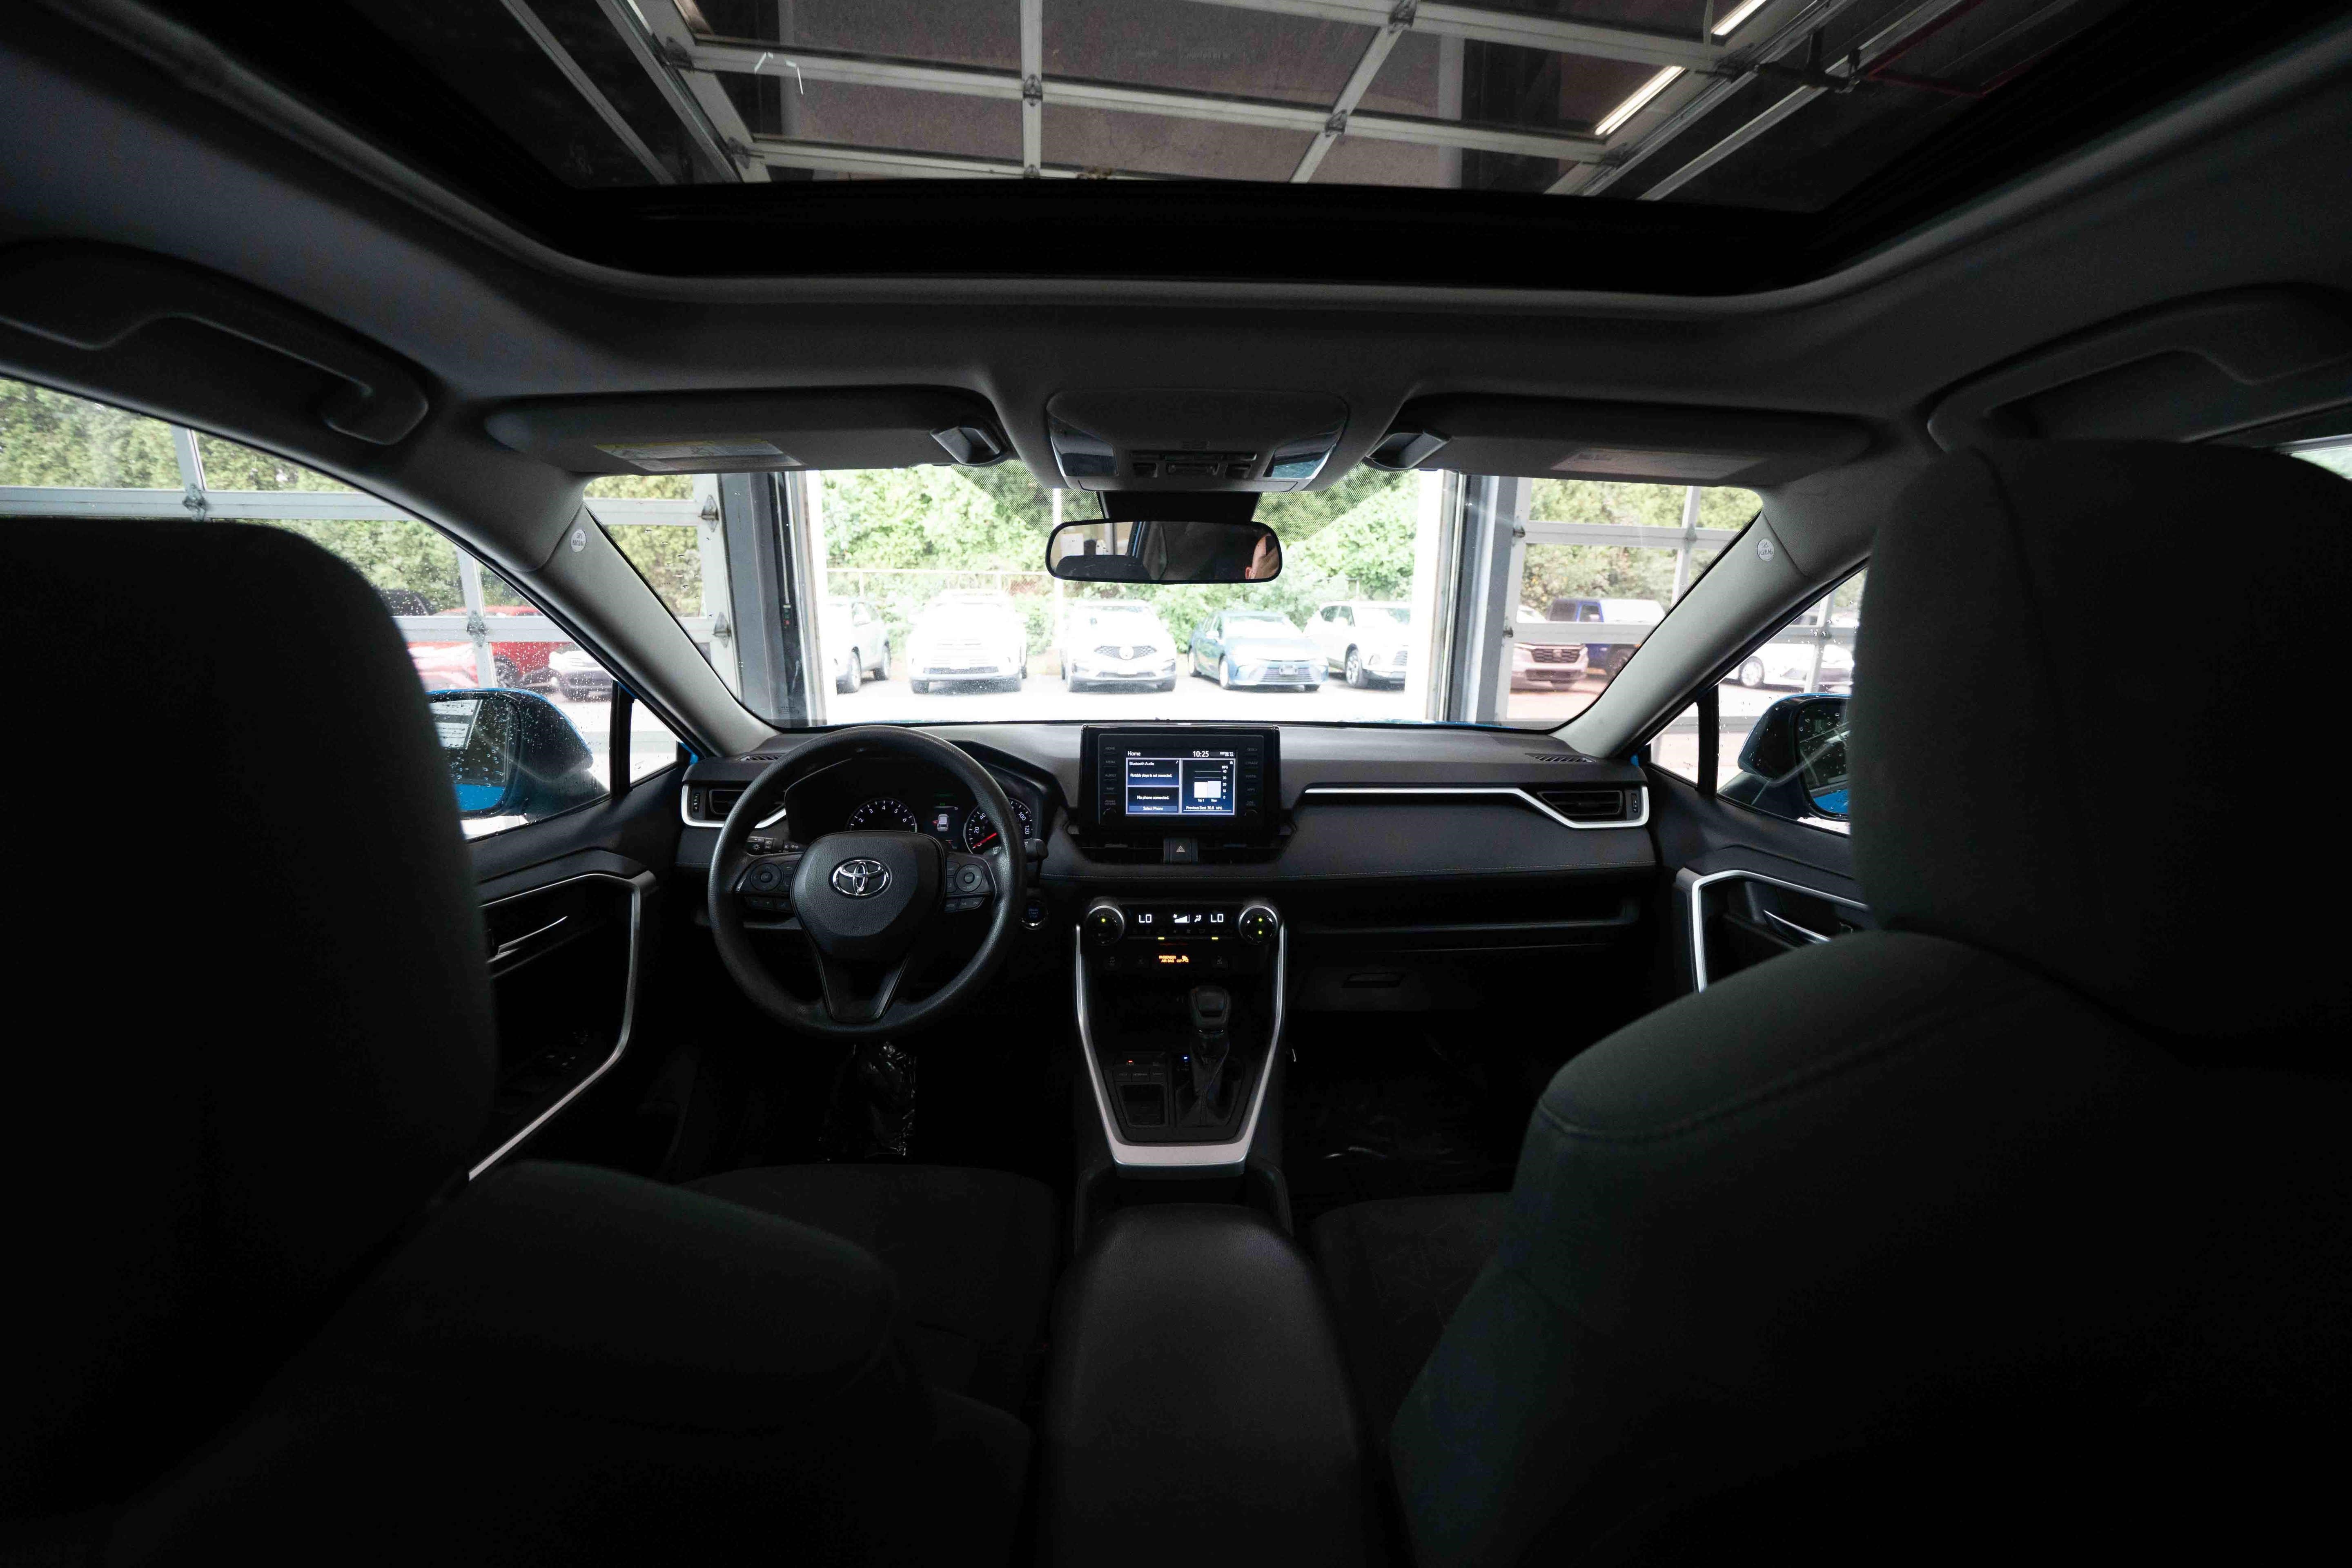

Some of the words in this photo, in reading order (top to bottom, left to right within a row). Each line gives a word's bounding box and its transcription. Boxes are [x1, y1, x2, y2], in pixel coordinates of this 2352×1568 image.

[1018, 812, 1026, 821] 100
[1138, 914, 1152, 923] LO
[1210, 913, 1224, 922] LO
